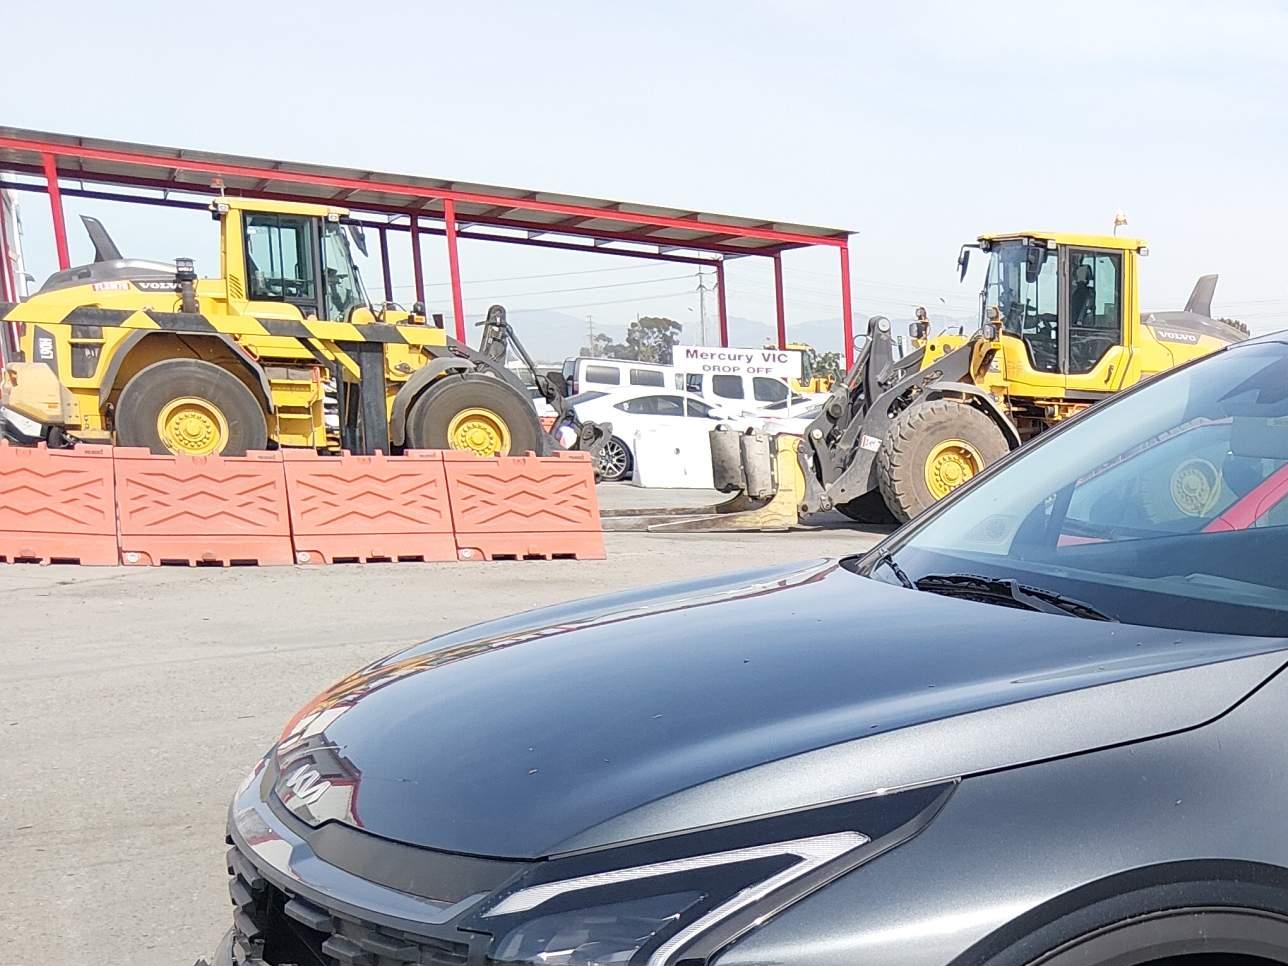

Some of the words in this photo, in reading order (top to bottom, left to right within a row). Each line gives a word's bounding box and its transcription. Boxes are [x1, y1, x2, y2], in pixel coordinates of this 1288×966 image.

[1158, 331, 1197, 341] VOLVO
[685, 348, 754, 364] Mercury
[761, 352, 789, 364] VIC
[702, 364, 741, 373] DROP
[746, 366, 773, 375] OFF
